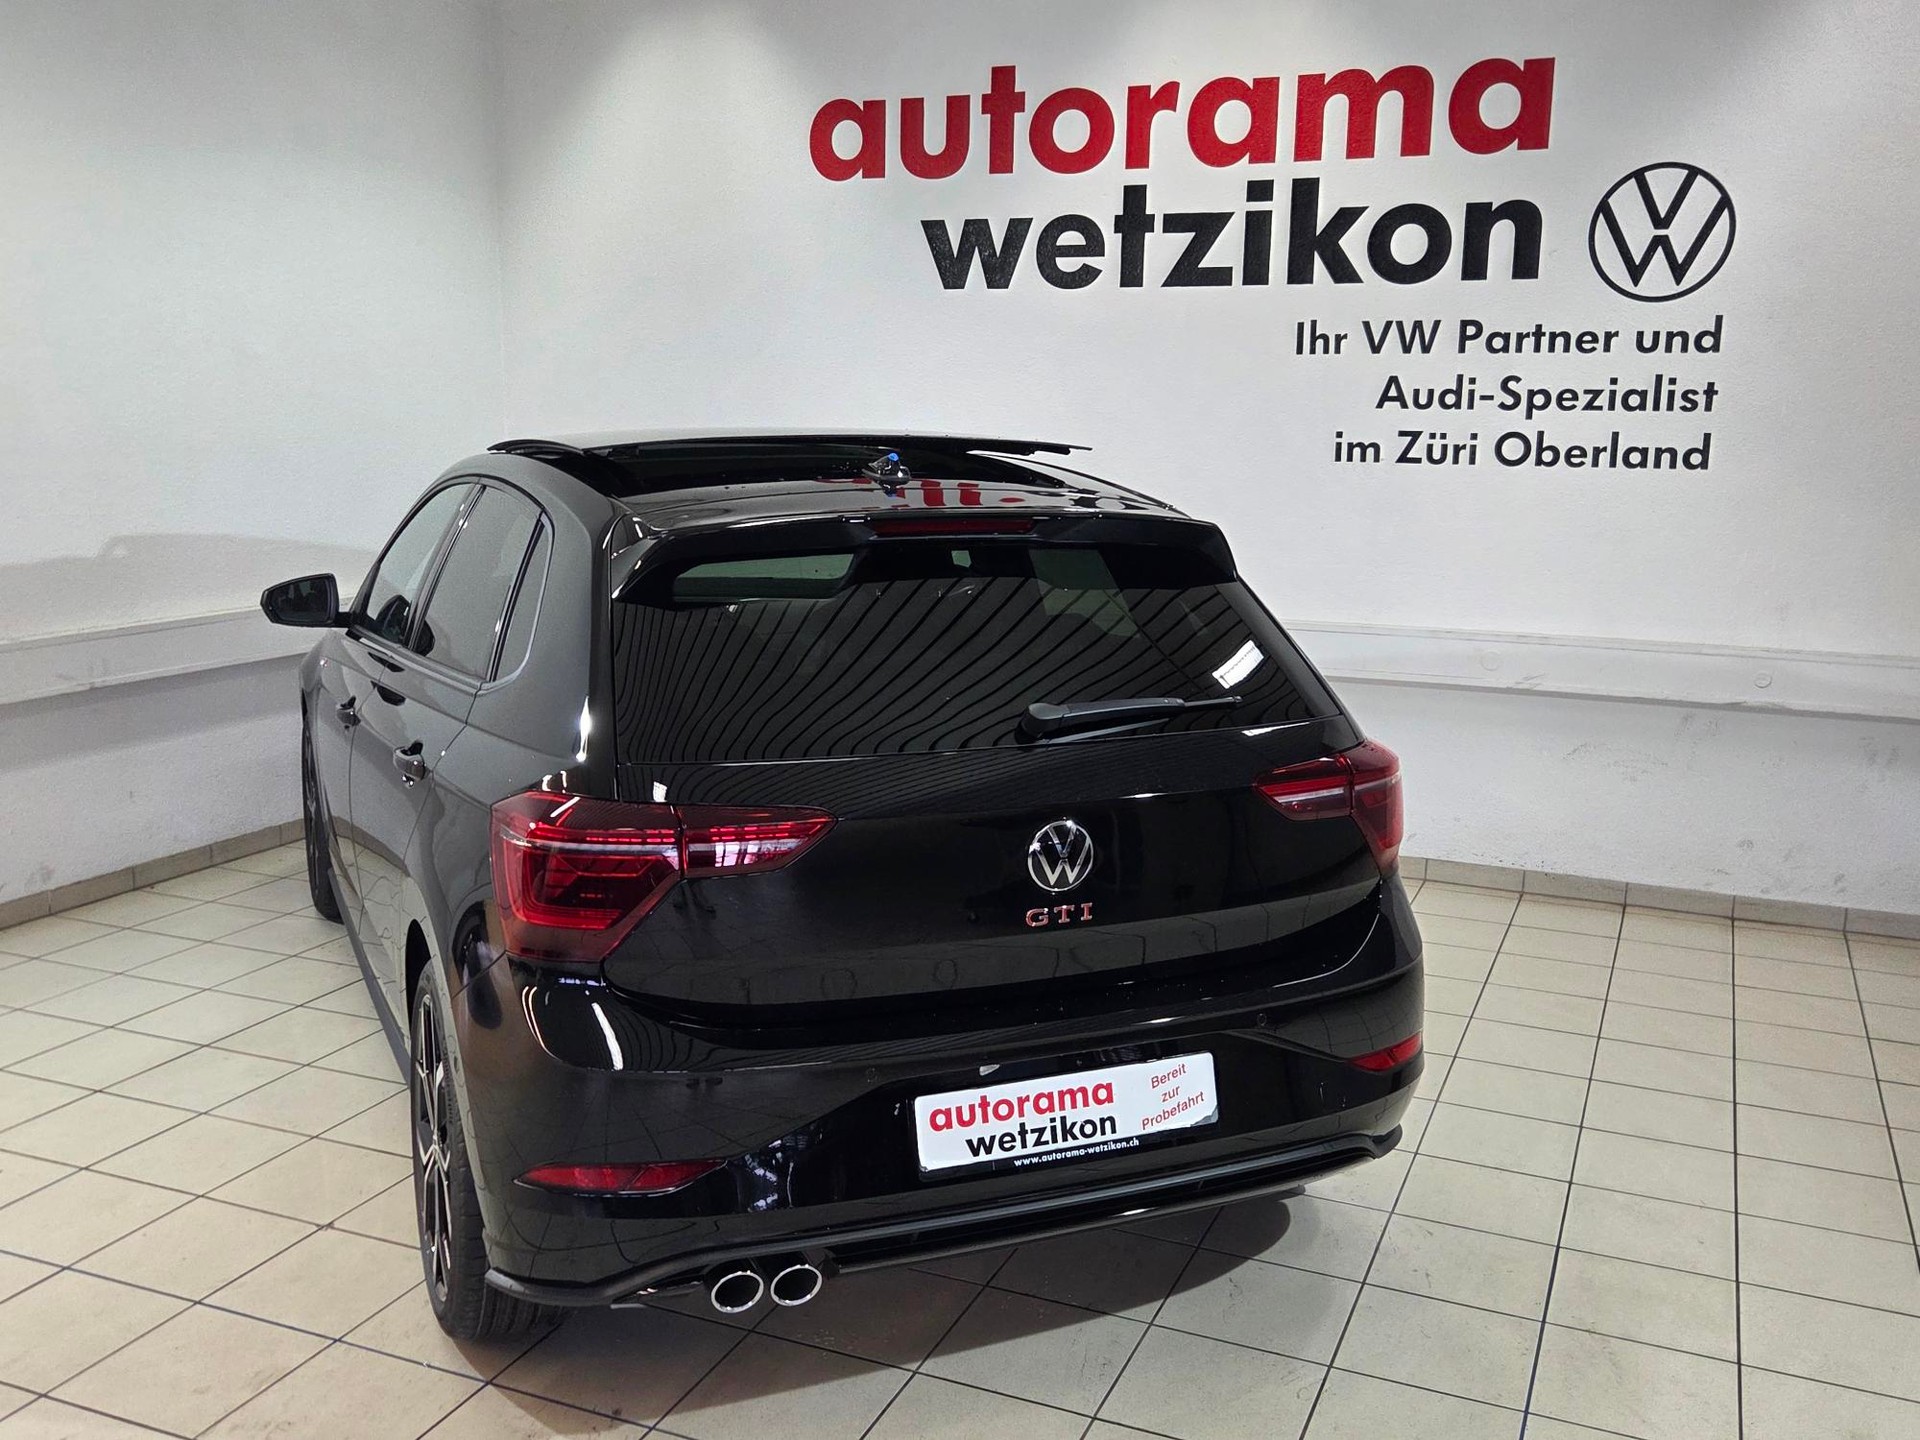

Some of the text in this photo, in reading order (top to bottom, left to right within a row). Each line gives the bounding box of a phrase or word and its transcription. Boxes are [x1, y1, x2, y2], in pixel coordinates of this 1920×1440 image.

[809, 56, 1556, 182] autorama
[920, 177, 1543, 290] wetzikon
[1295, 314, 1724, 355] Ihr VW Partner und
[1375, 373, 1719, 420] Audi-Spezialist
[1334, 430, 1712, 471] im Züri Oberland
[1025, 902, 1093, 927] GTI
[1150, 1062, 1187, 1089] Bereit
[1161, 1083, 1181, 1103] zur
[928, 1081, 1115, 1132] autorama
[1140, 1091, 1205, 1131] Probefahrt
[965, 1114, 1117, 1157] wetzikon
[1013, 1137, 1140, 1167] www.autorama-wetzikon.ch
